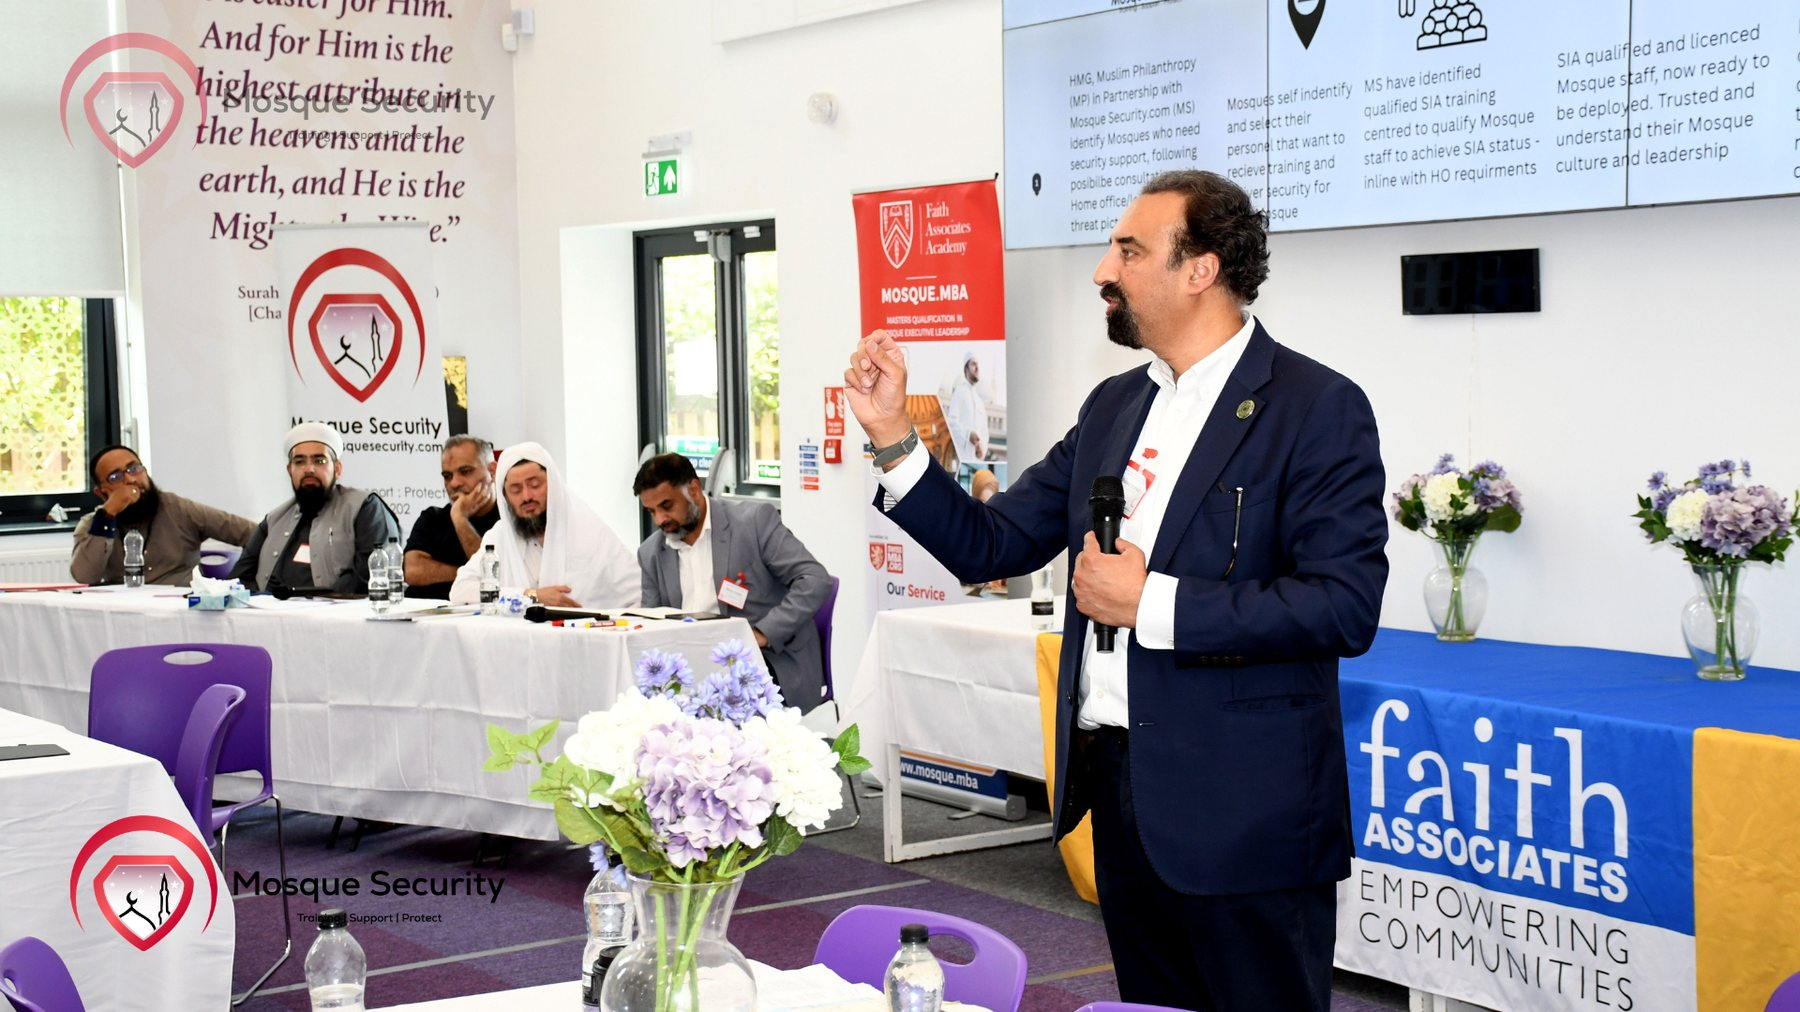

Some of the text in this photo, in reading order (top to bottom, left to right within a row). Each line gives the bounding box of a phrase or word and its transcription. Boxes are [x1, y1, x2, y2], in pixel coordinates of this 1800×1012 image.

[386, 0, 453, 18] Him.
[200, 21, 453, 64] And for Him is the
[1557, 23, 1761, 68] SIA qualifed and licenced
[1069, 58, 1196, 87] HMG, Muslim Philanthropy
[1364, 64, 1482, 93] MS have identified
[1557, 53, 1770, 94] Mosque staff, now ready to
[195, 67, 461, 110] highest attribute in
[1069, 80, 1183, 110] (MP) in Partnership with
[1227, 82, 1353, 112] Mosques self indentify
[1557, 81, 1755, 121] be deployed. Trusted and
[1070, 100, 1196, 130] Mosque Security.com (MS)
[1364, 89, 1497, 118] qualified SIA training
[196, 115, 465, 154] the heavens and the
[1108, 130, 1150, 146] Mosques
[1153, 126, 1173, 140] who
[1175, 122, 1200, 136] need
[1227, 111, 1311, 134] and select their
[1364, 111, 1535, 142] centred to qualify Mosque
[1556, 113, 1754, 147] understand their Mosque
[1070, 145, 1198, 171] security support, following
[1227, 132, 1345, 157] personel that want to
[1364, 148, 1392, 166] staff
[1395, 149, 1408, 163] to
[1411, 143, 1461, 161] achieve
[1464, 140, 1485, 156] SIA
[1489, 136, 1532, 153] status
[1556, 142, 1729, 173] culture and leadership
[1227, 155, 1336, 178] recieve training and
[1364, 161, 1537, 190] inline with HO requirments
[199, 164, 466, 200] earth, and He is the
[1267, 181, 1311, 199] security
[1314, 180, 1331, 193] for
[925, 202, 949, 218] Faith
[1071, 197, 1097, 211] Home
[925, 220, 971, 237] Associates
[1071, 218, 1098, 232] threat
[925, 238, 968, 255] Academy
[238, 285, 280, 299] Surah
[881, 284, 969, 305] MOSQUE.MBA
[912, 314, 955, 325] QUALIFICATION
[935, 327, 970, 336] LEADERSHIP
[370, 416, 442, 439] Security
[404, 486, 446, 499] Protect
[887, 582, 945, 601] Our Service
[900, 762, 978, 789] ww.mosque.mba
[1360, 699, 1628, 859] faith
[1363, 812, 1628, 903] ASSOCIATES
[1361, 870, 1628, 964] EMPOWERING
[1359, 912, 1633, 1012] COMMUNITIES
